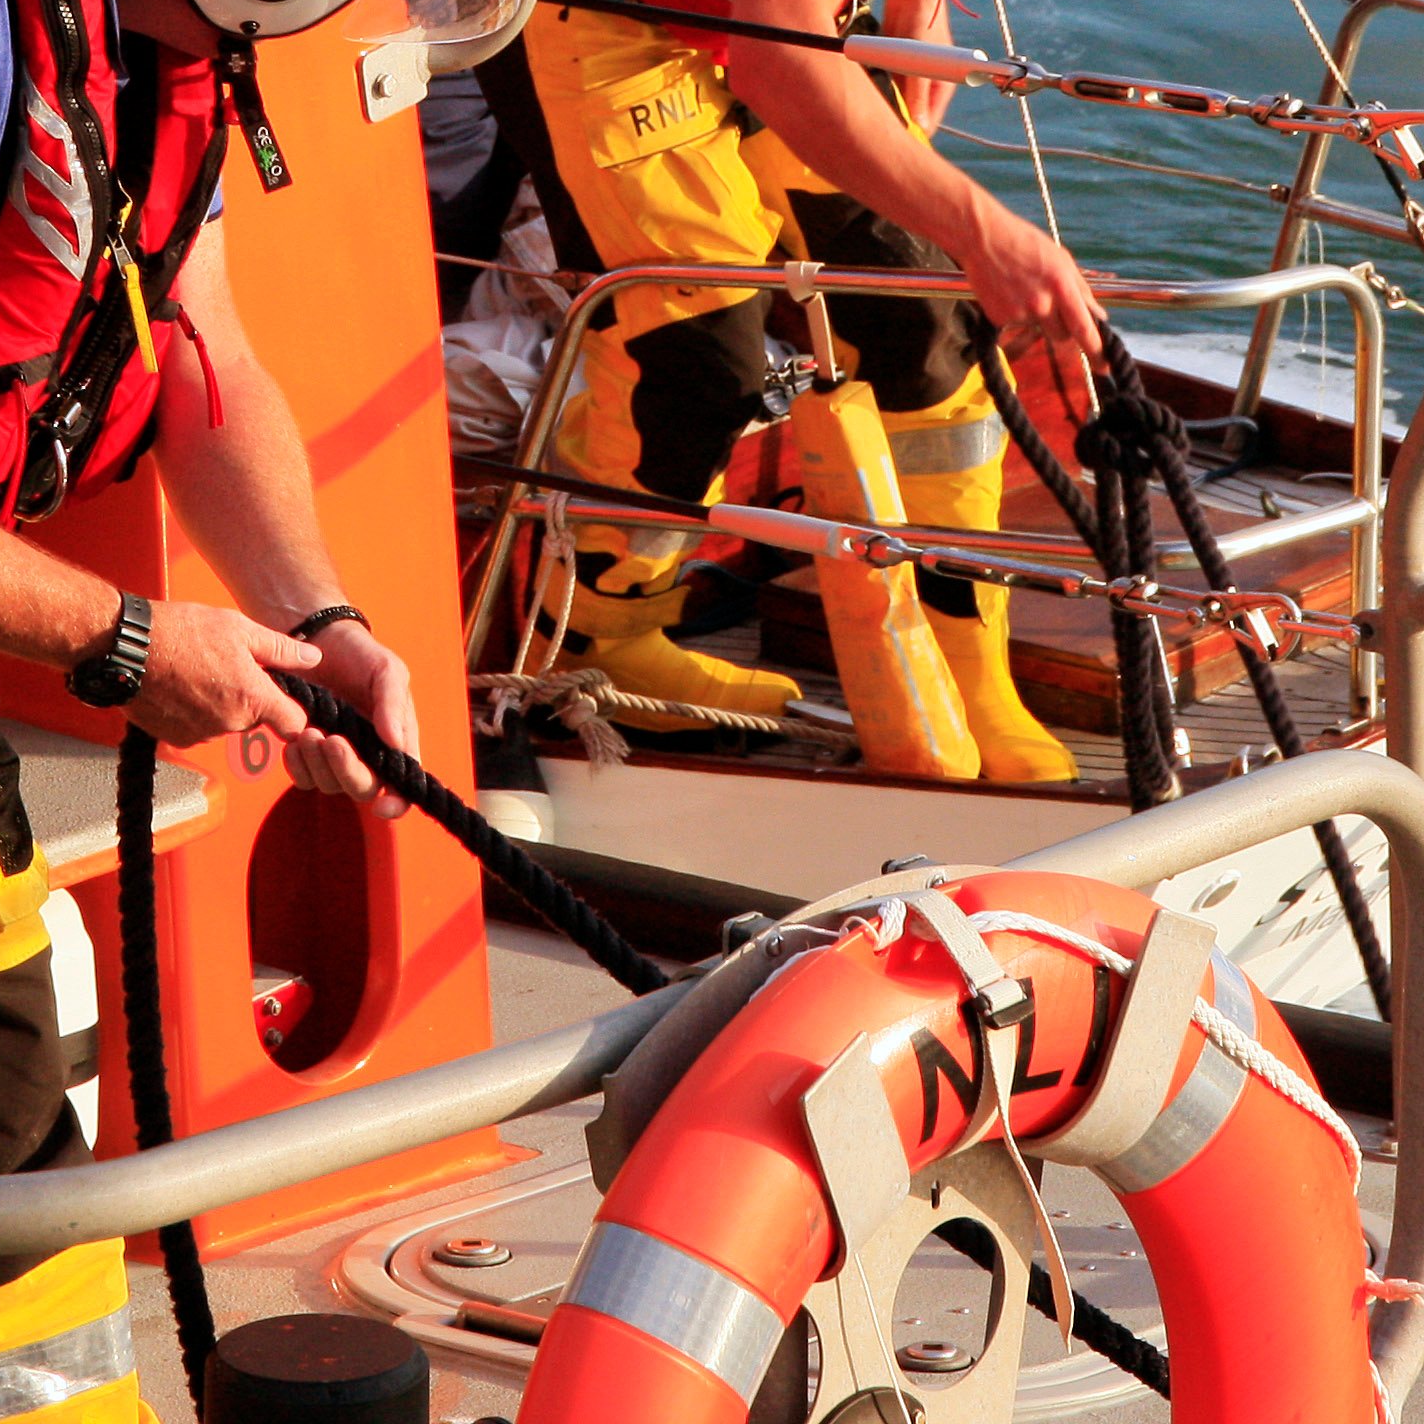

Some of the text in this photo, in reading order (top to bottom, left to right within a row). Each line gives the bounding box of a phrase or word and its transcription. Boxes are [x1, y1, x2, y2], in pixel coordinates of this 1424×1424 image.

[629, 83, 702, 137] RNLI
[258, 127, 282, 176] GECKO
[911, 965, 1111, 1145] NLI
